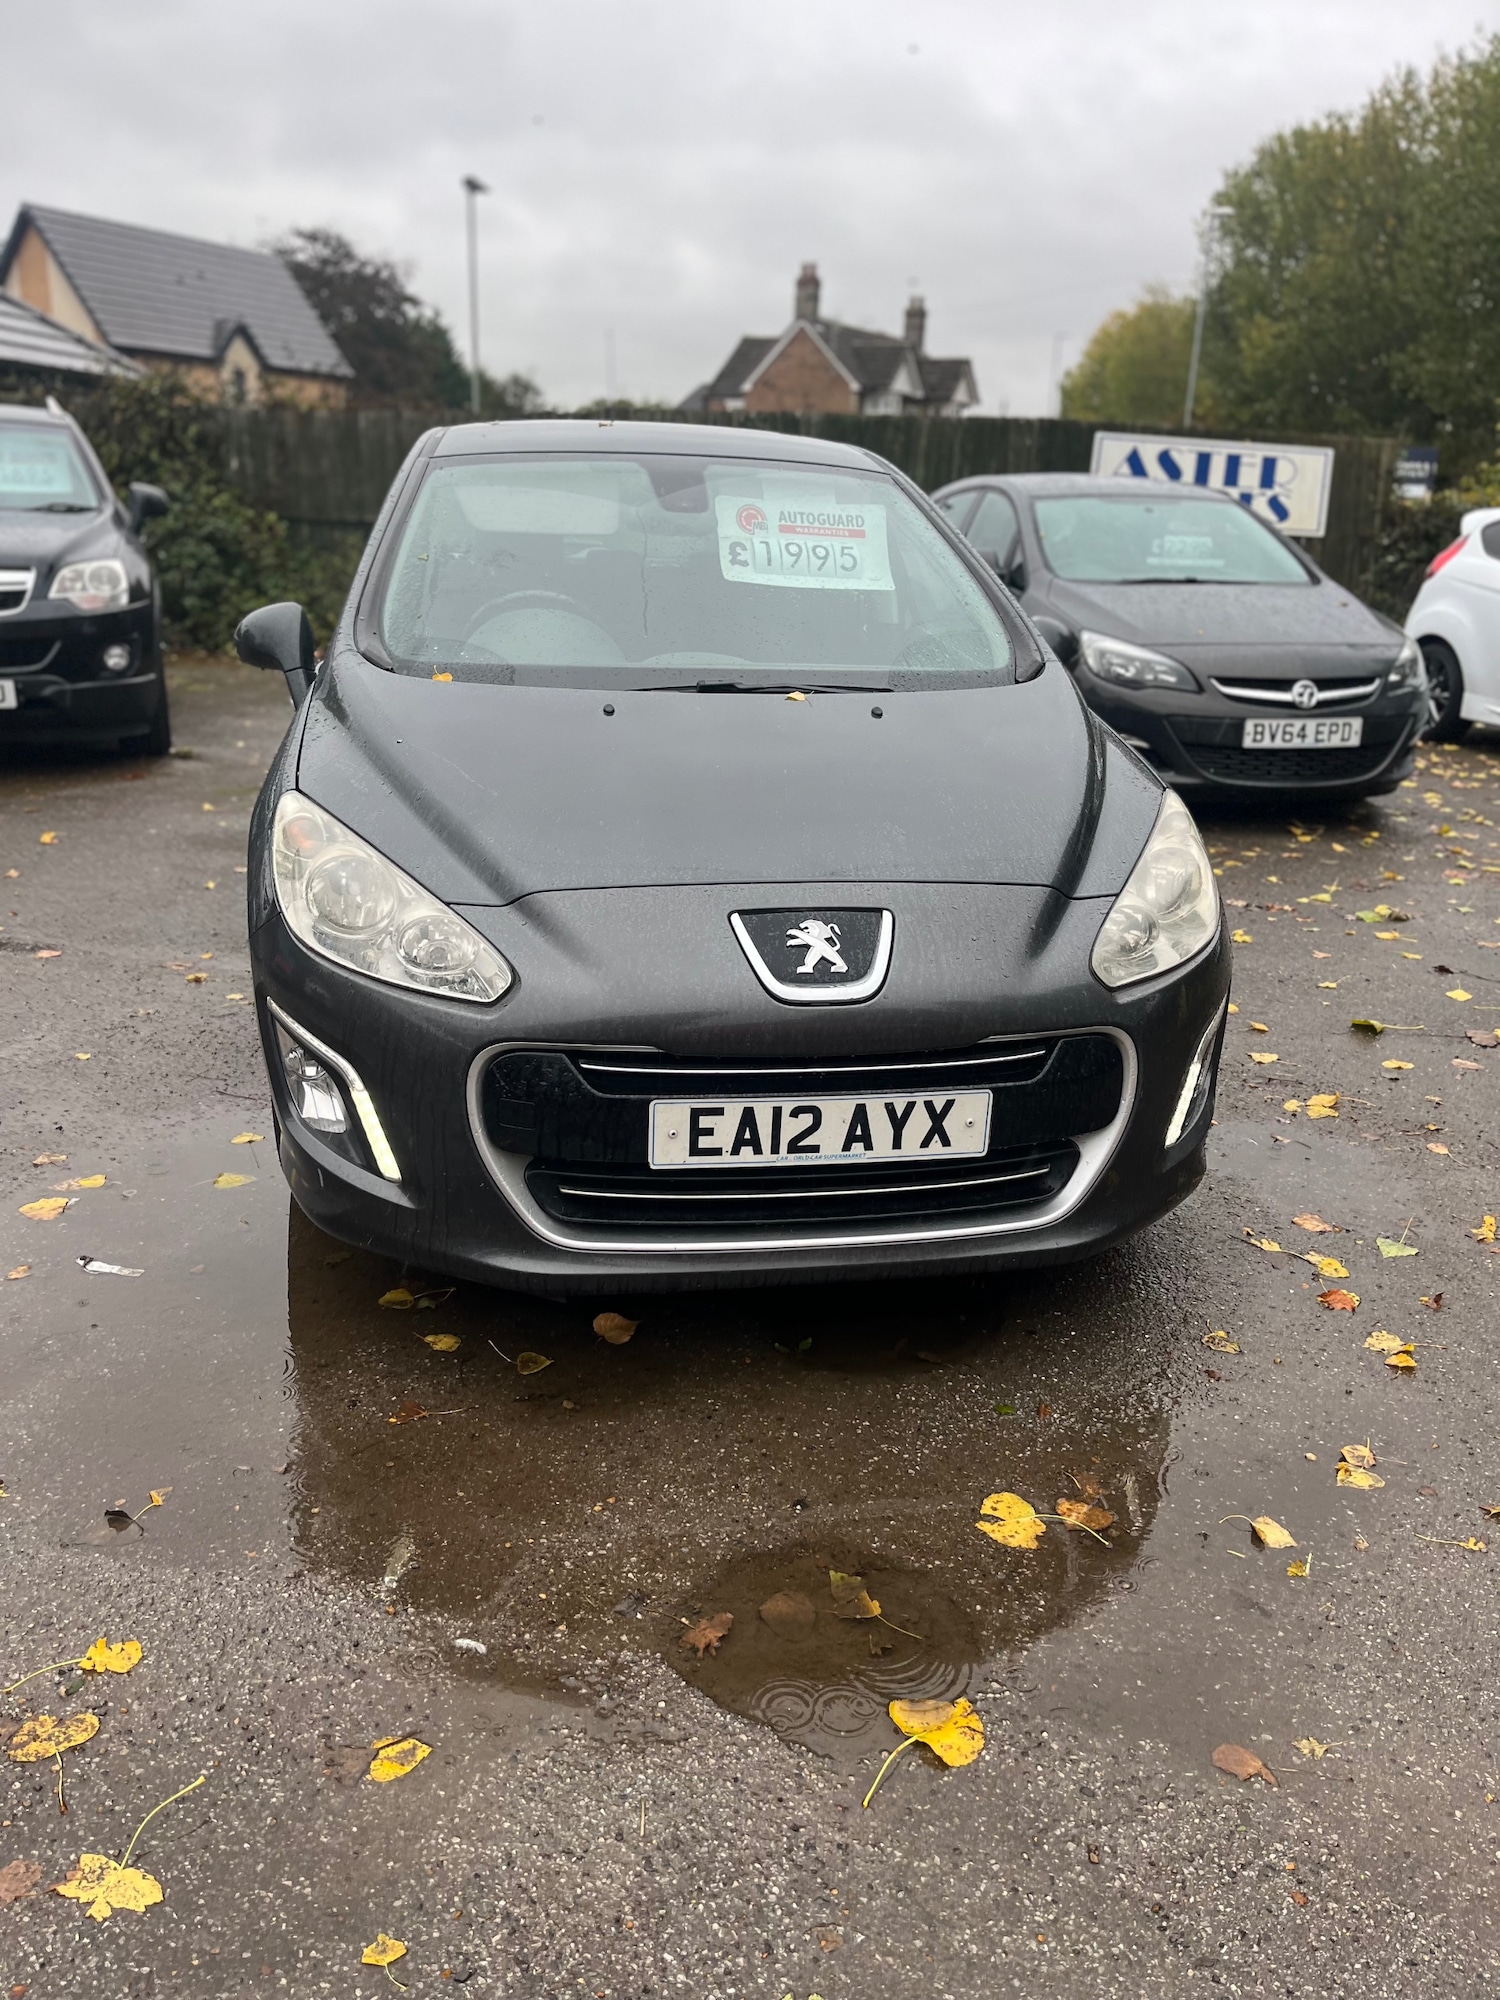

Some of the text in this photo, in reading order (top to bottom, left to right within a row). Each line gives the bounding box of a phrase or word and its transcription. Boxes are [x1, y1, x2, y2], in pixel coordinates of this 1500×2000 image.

[778, 510, 865, 528] AUTOGUARD
[795, 527, 849, 537] WARRANTIES
[728, 541, 858, 572] £1995
[1252, 722, 1352, 743] BV64 EPD
[689, 1099, 956, 1157] EA12 AYX
